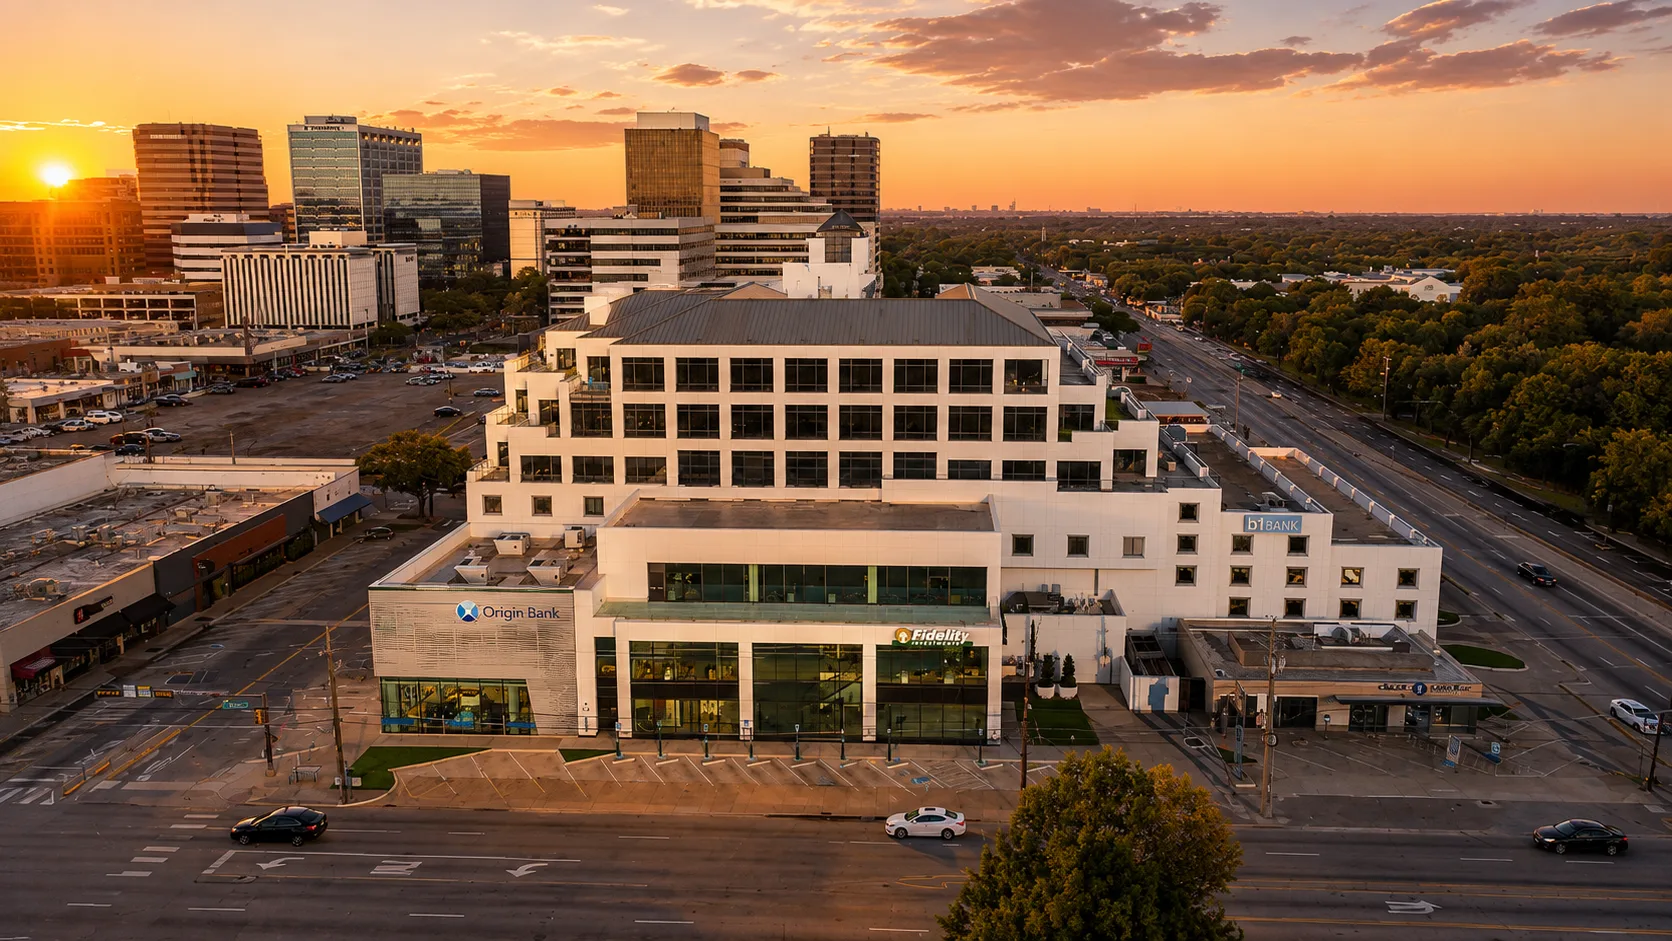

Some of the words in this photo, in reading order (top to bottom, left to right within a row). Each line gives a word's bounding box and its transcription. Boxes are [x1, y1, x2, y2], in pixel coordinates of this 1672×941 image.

[483, 606, 524, 621] Origin
[528, 607, 560, 619] Bank
[911, 628, 970, 645] Fidelity
